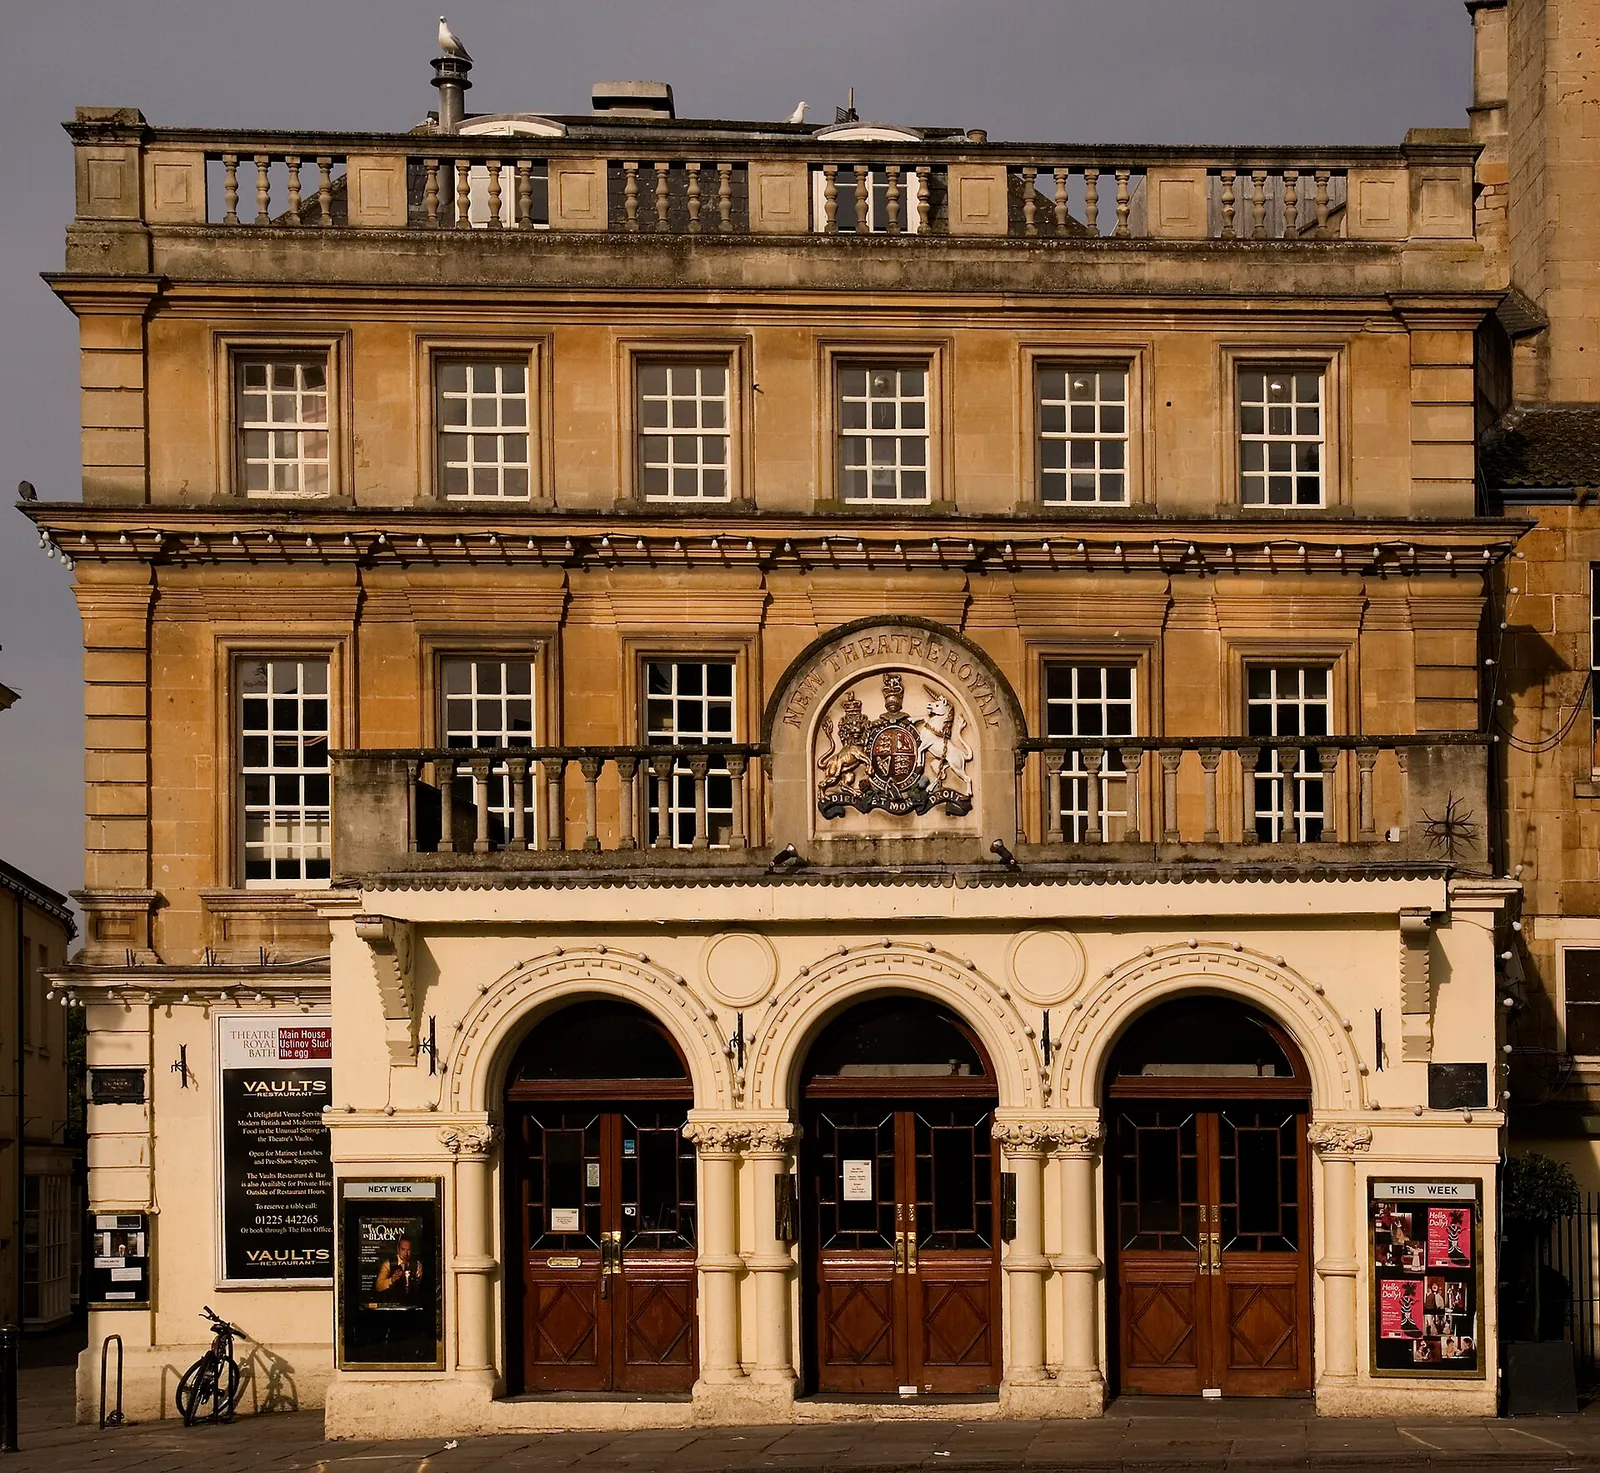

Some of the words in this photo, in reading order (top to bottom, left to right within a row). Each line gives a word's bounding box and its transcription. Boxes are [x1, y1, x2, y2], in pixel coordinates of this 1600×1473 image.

[783, 667, 825, 730] NEW
[821, 634, 941, 673] THEATRE
[942, 652, 1003, 730] ROYAL
[889, 798, 914, 811] MON
[929, 791, 963, 804] DROIT
[230, 1030, 276, 1040] THEATRE
[279, 1029, 299, 1039] Main
[301, 1029, 326, 1039] House
[243, 1039, 276, 1049] ROYAL
[279, 1039, 309, 1049] Ustinov
[311, 1038, 332, 1048] Studi
[249, 1048, 276, 1058] BATH
[280, 1048, 293, 1058] the
[294, 1049, 309, 1059] egg
[243, 1080, 327, 1092] VAULTS
[253, 1111, 282, 1119] Delightful
[301, 1110, 322, 1118] Servin
[242, 1127, 258, 1135] Food
[299, 1126, 320, 1135] Setting
[248, 1150, 265, 1158] Open
[265, 1149, 274, 1157] for
[293, 1157, 319, 1166] Suppers.
[368, 1185, 388, 1193] NEXT
[389, 1185, 412, 1193] WEEK
[1390, 1185, 1416, 1195] THIS
[1428, 1185, 1459, 1195] WEEK
[255, 1215, 283, 1225] 01225
[284, 1214, 319, 1225] 442265
[1429, 1211, 1448, 1220] Hello,
[1429, 1219, 1449, 1229] Dolly!
[264, 1227, 288, 1235] through
[368, 1224, 406, 1236] WOMAN
[368, 1233, 396, 1241] BLACK
[245, 1249, 330, 1261] VAULTS
[1382, 1282, 1401, 1292] Hello,
[1382, 1290, 1402, 1300] Dolly!
